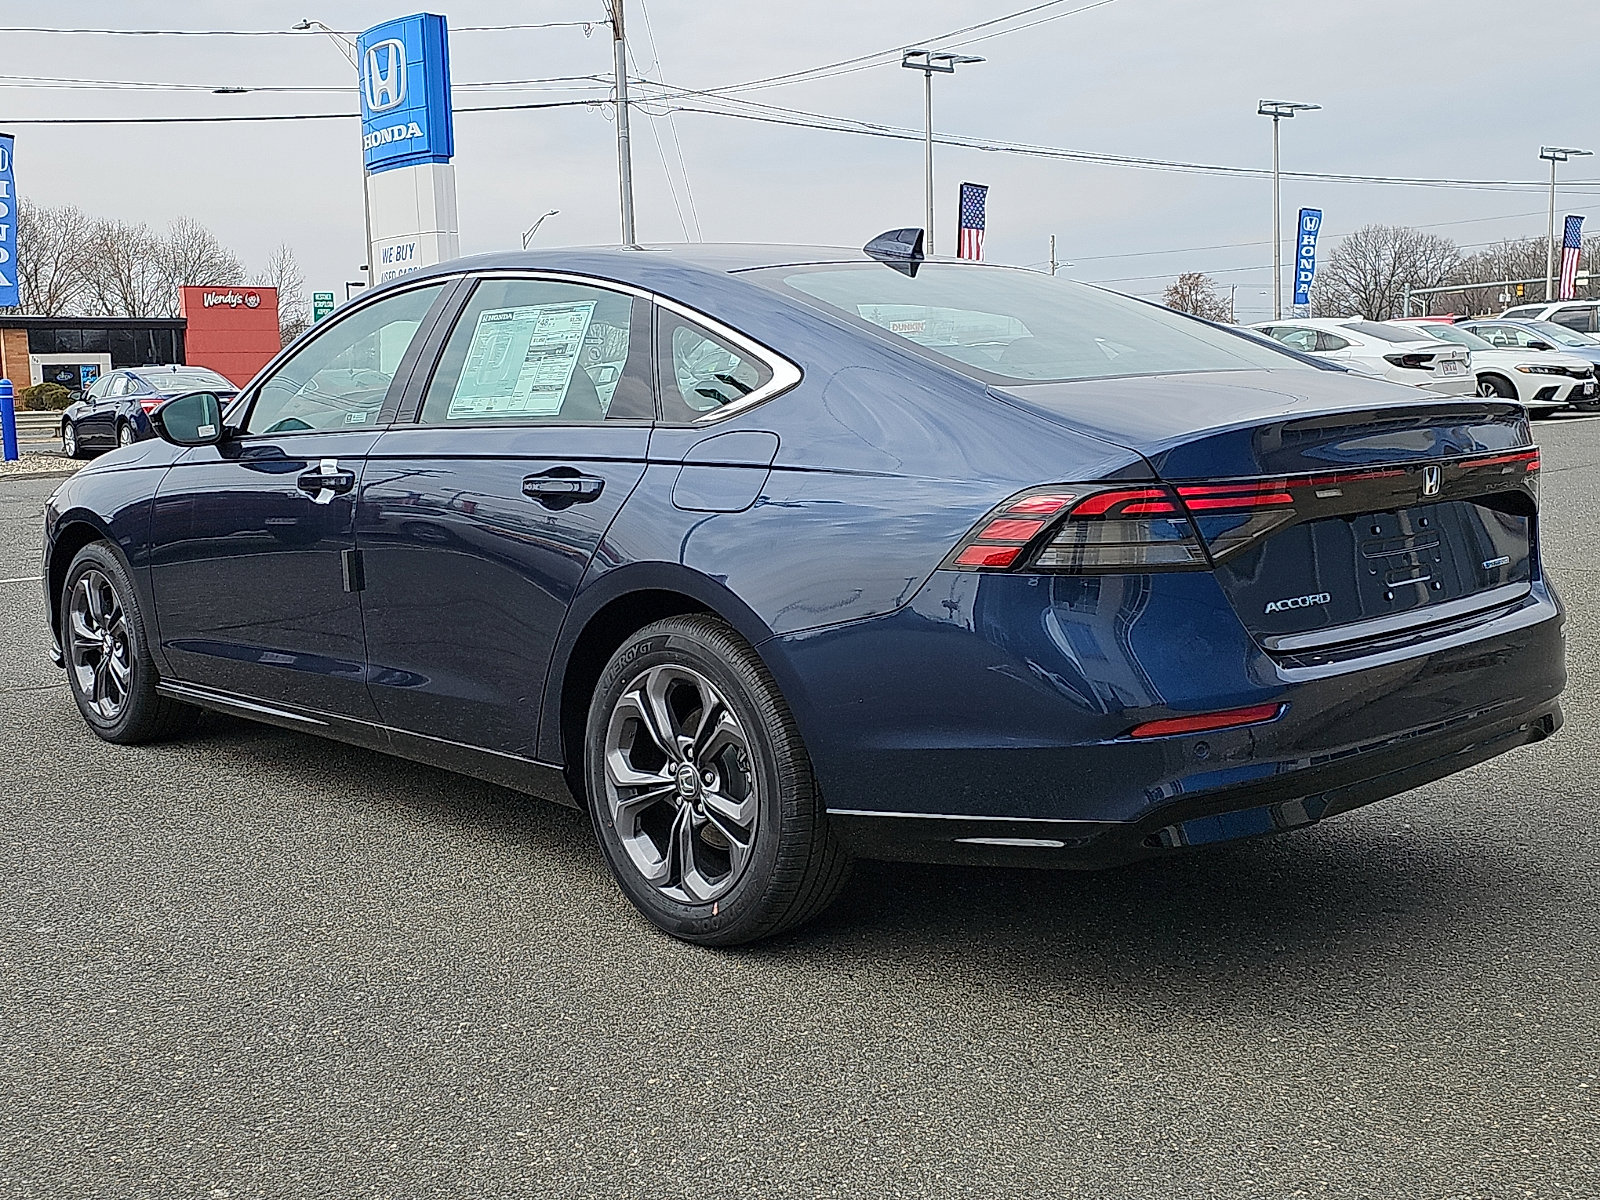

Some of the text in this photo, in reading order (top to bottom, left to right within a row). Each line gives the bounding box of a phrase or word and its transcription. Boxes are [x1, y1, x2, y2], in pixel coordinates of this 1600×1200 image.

[363, 122, 423, 150] HONDA
[382, 243, 415, 264] WE BUY
[1297, 235, 1316, 293] HONDA
[203, 290, 243, 307] Wendy's
[1264, 593, 1330, 614] ACCORD
[640, 641, 652, 653] GT
